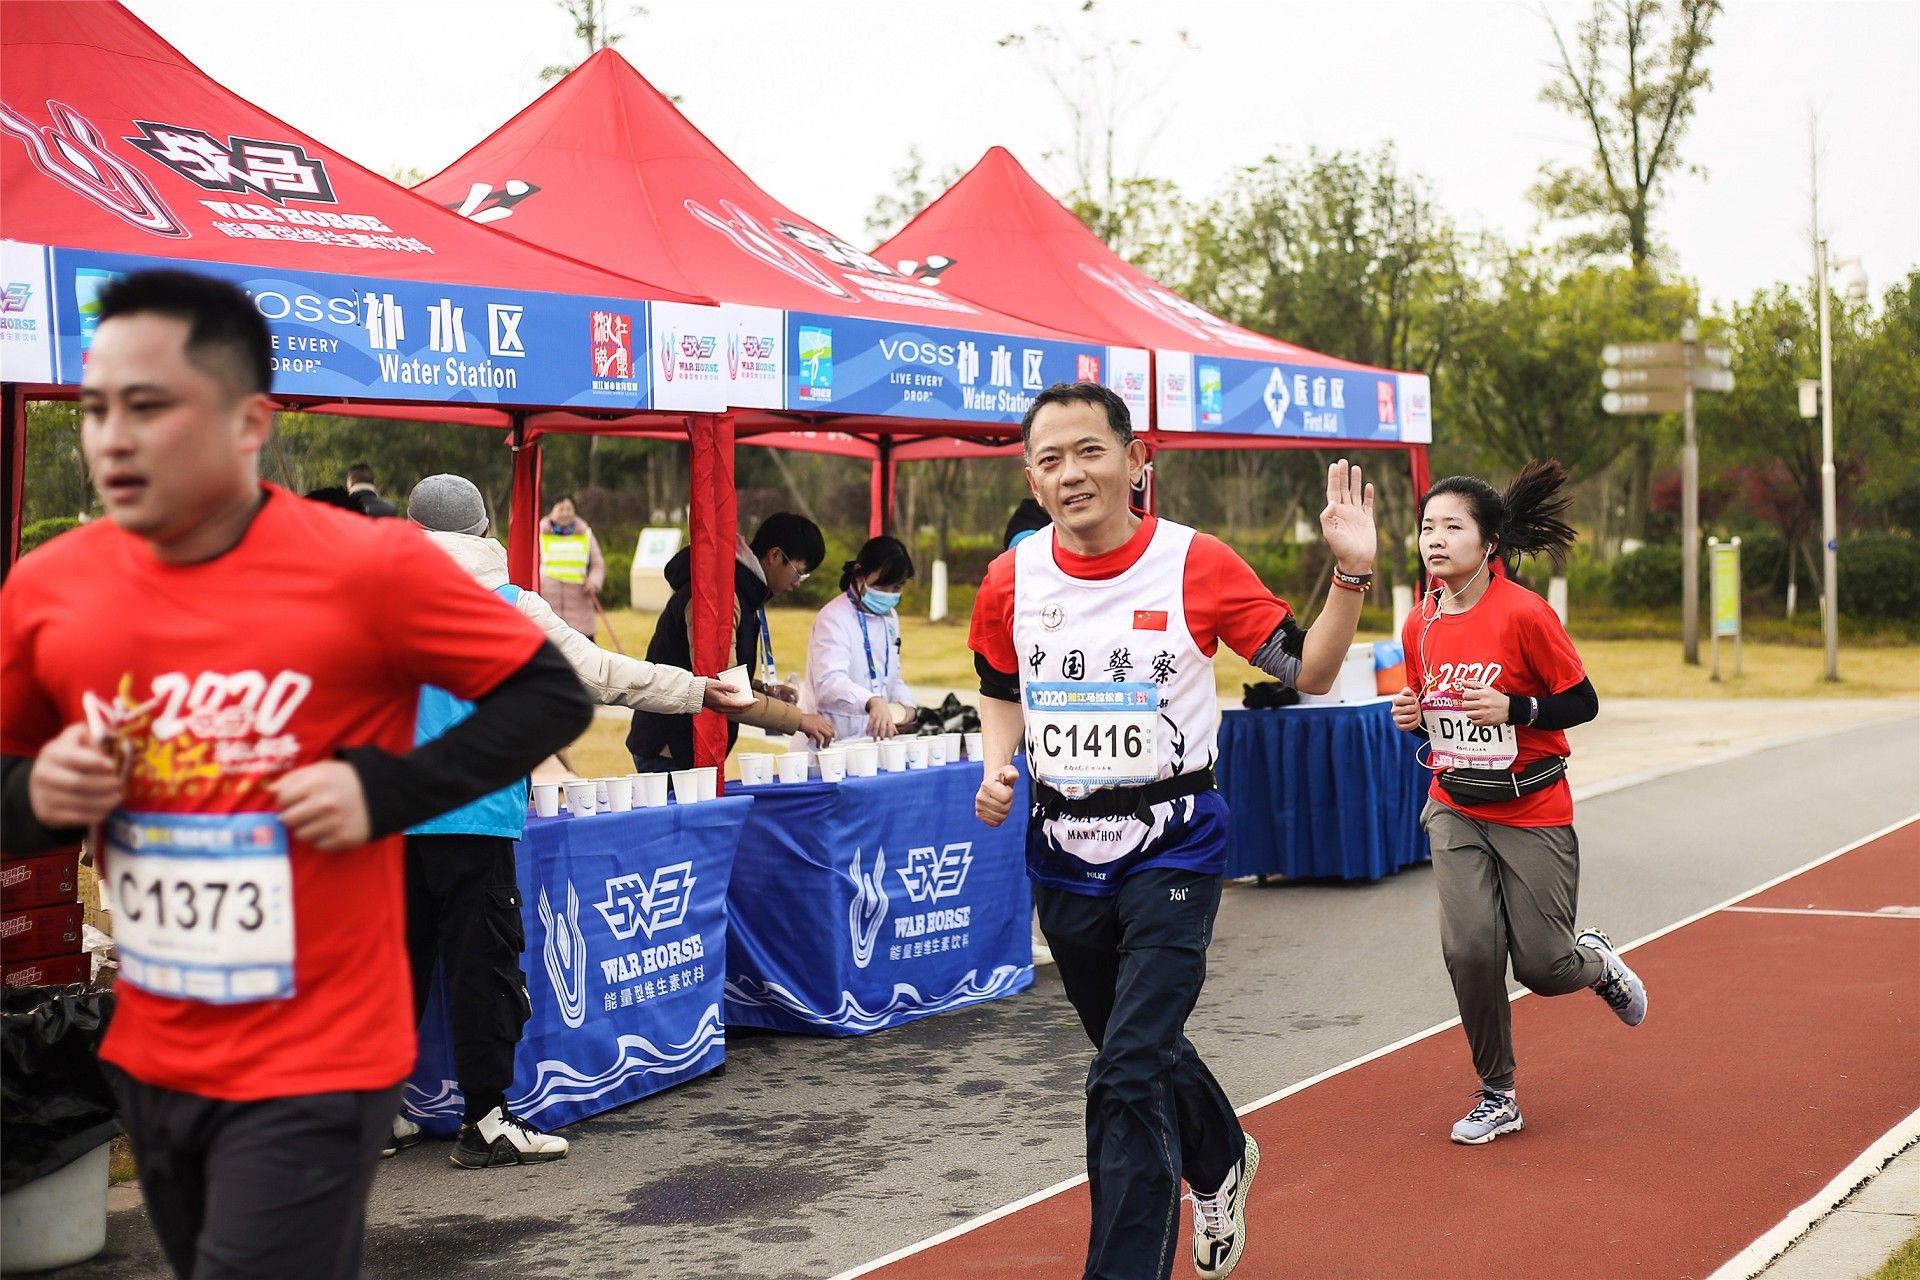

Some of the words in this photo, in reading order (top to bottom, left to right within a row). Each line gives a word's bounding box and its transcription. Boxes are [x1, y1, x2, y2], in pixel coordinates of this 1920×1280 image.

[199, 200, 285, 222] WAR
[274, 207, 394, 233] HORSE
[244, 290, 357, 325] OSS
[363, 292, 526, 358] 补水区
[288, 336, 339, 353] EVERY
[879, 338, 954, 366] VOSS
[378, 353, 441, 384] Water
[445, 357, 518, 389] Station
[679, 362, 694, 371] WAR
[695, 363, 718, 373] HORSE
[890, 372, 911, 385] LIVE
[915, 374, 944, 388] EVERY
[957, 340, 1044, 390] 补水区
[963, 387, 997, 410] Water
[1303, 410, 1323, 432] First
[1323, 412, 1337, 432] Aid
[1029, 644, 1177, 684] 中国警察
[1043, 724, 1142, 758] C1416
[1439, 718, 1503, 742] D1261
[1067, 830, 1123, 841] MARATHON
[1087, 872, 1106, 880] POLICE
[119, 872, 264, 932] C1373
[895, 913, 926, 938] WAR
[926, 906, 971, 934] HORSE
[600, 952, 643, 985] WAR
[641, 933, 705, 975] HORSE
[604, 965, 705, 1012] 能量型维生素饮料
